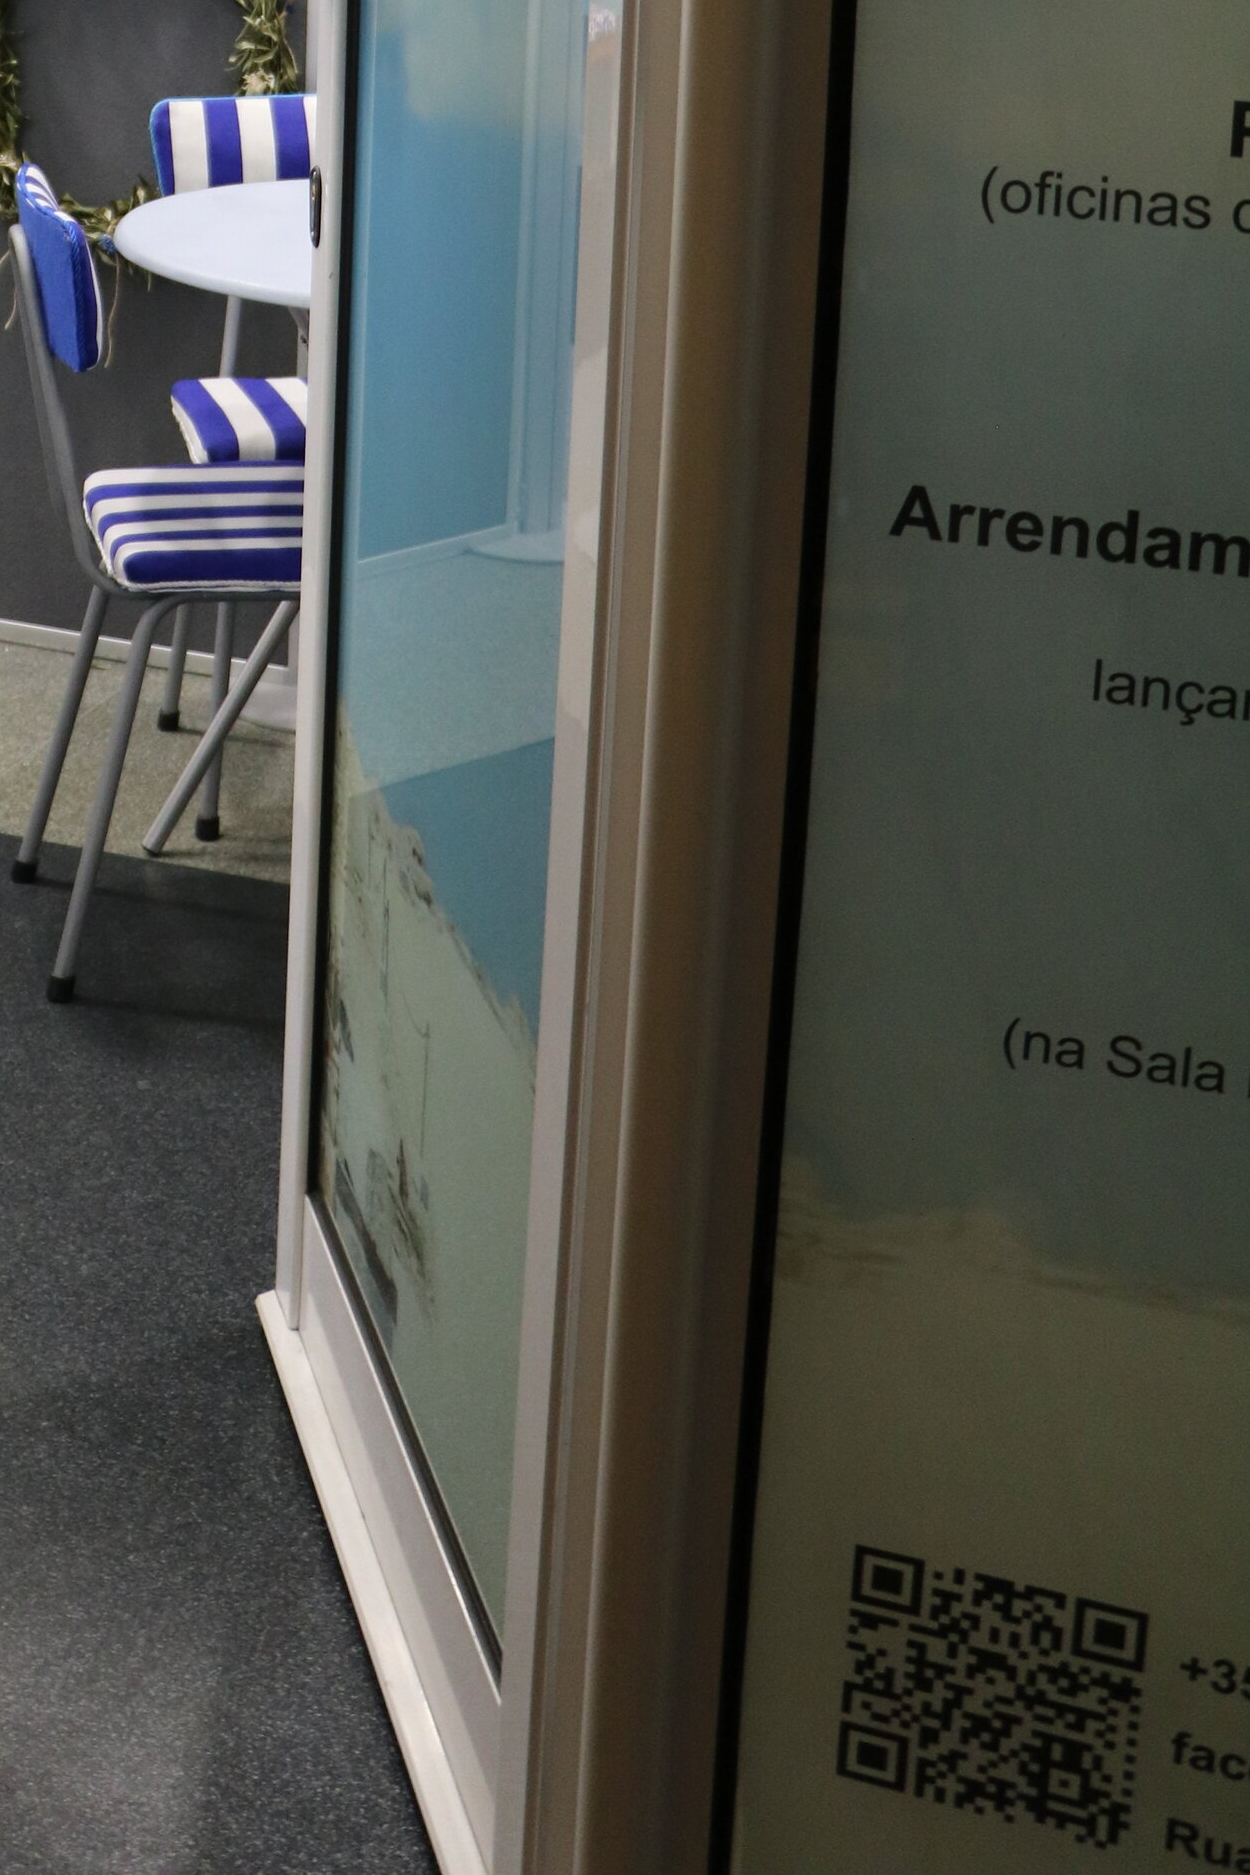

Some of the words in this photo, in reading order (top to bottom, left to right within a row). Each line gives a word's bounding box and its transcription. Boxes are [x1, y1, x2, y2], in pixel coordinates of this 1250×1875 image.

[981, 166, 1211, 229] (oficinas
[889, 484, 1250, 578] Arrendam
[1092, 658, 1250, 725] lança
[1003, 1017, 1085, 1070] (na
[1106, 1035, 1226, 1094] Sala
[1171, 1731, 1250, 1781] fac
